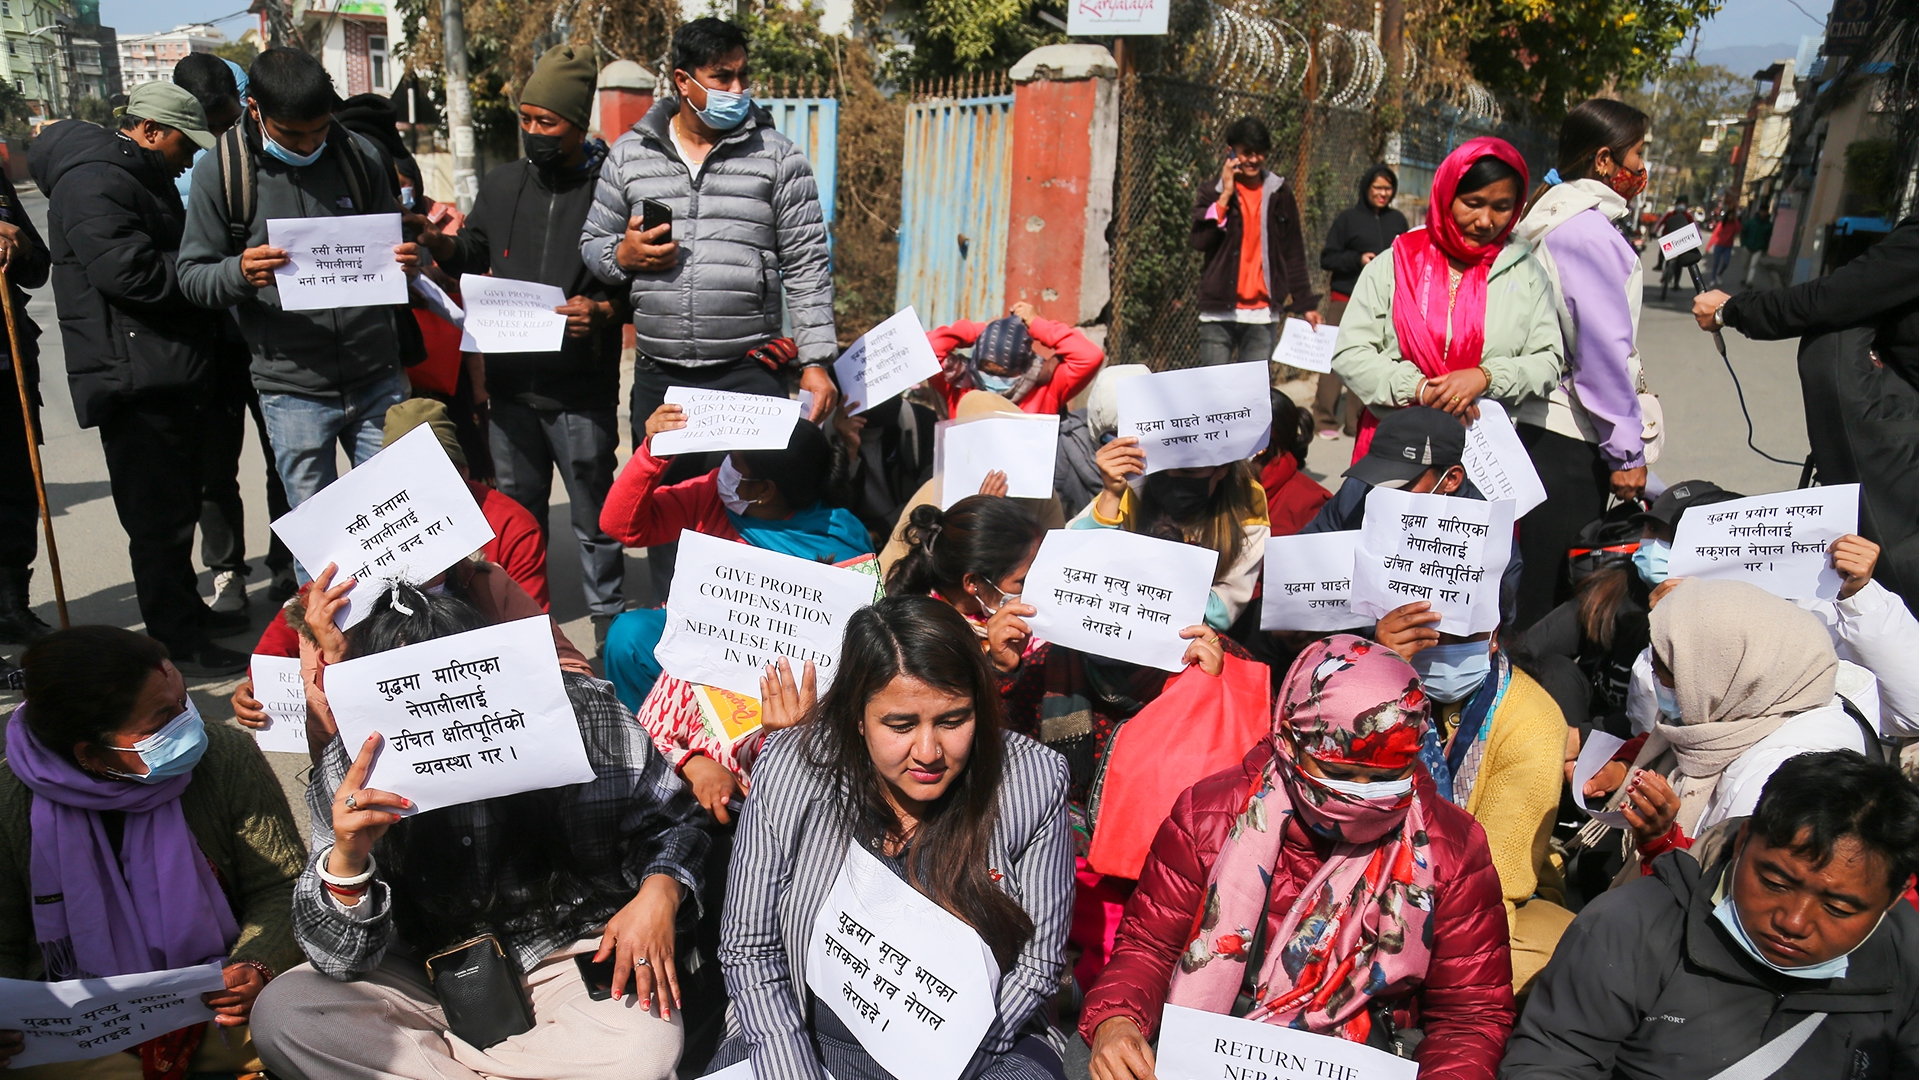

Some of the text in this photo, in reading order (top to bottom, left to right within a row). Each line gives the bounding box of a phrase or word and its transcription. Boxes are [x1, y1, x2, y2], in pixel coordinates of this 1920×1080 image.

[335, 243, 365, 255] सेनामा
[316, 257, 363, 270] नेपालीलाई
[321, 273, 336, 285] गर्न
[363, 273, 376, 282] गर
[484, 289, 542, 300] GIVE PROPER
[477, 319, 553, 328] NEPALESE KILLED
[498, 309, 536, 318] FOR THE
[688, 394, 736, 403] SAFELY
[693, 403, 725, 416] USED
[728, 404, 782, 416] CITIZEN
[680, 426, 760, 440] RETURN THE
[694, 414, 757, 429] NEPALESE
[1135, 407, 1251, 436] युद्धमा घाइते भएकाको
[1161, 434, 1199, 447] उपचार
[1204, 431, 1220, 442] गर
[1463, 440, 1496, 496] OUNDED
[1471, 422, 1515, 498] TREAT THE
[345, 488, 411, 536] रुसी सेनामा
[1707, 504, 1824, 526] युद्धमा प्रयोग भएका
[360, 508, 420, 552] नेपालीलाई
[1401, 513, 1489, 538] युद्धमा मारिएका
[1729, 522, 1793, 538] नेपालीलाई
[374, 547, 396, 569] गर्न
[398, 533, 425, 554] बन्द
[425, 520, 445, 538] गर
[1407, 533, 1468, 560] नेपालीलाई
[1695, 539, 1827, 561] सकुशल नेपाल फिर्ता
[1383, 555, 1485, 585] उचित क्षतिपूर्तिको
[1743, 562, 1764, 572] गर
[715, 565, 823, 604] GIVE PROPER
[1063, 567, 1173, 602] युद्धमा मृत्यु भएका
[1284, 577, 1351, 596] युद्धमा घाइते
[1388, 579, 1433, 600] व्यवस्था
[1440, 587, 1459, 604] गर
[699, 582, 833, 626] COMPENSATION
[1054, 588, 1171, 625] मृतकको शव नेपाल
[1308, 598, 1347, 609] उपचार
[728, 609, 798, 638] FOR THE
[1082, 615, 1123, 638] लेराइदे
[685, 618, 832, 669] NEPALESE KILLED
[724, 648, 741, 663] IN
[279, 672, 302, 684] RET
[377, 656, 501, 702] युद्धमा मारिएका
[406, 689, 488, 721] नेपालीलाई
[389, 710, 526, 753] उचित क्षतिपूर्तिको
[412, 751, 472, 778] व्यवस्था
[479, 748, 503, 767] गर
[838, 911, 958, 1003] युद्धमा मृत्यु भएका
[824, 932, 946, 1031] मृतकको शव नेपाल
[81, 1002, 121, 1022] मृत्यु
[101, 1013, 131, 1028] शव
[139, 997, 187, 1014] नेपाल
[842, 981, 881, 1024] लेराइदे
[1214, 1037, 1360, 1080] RETURN THE
